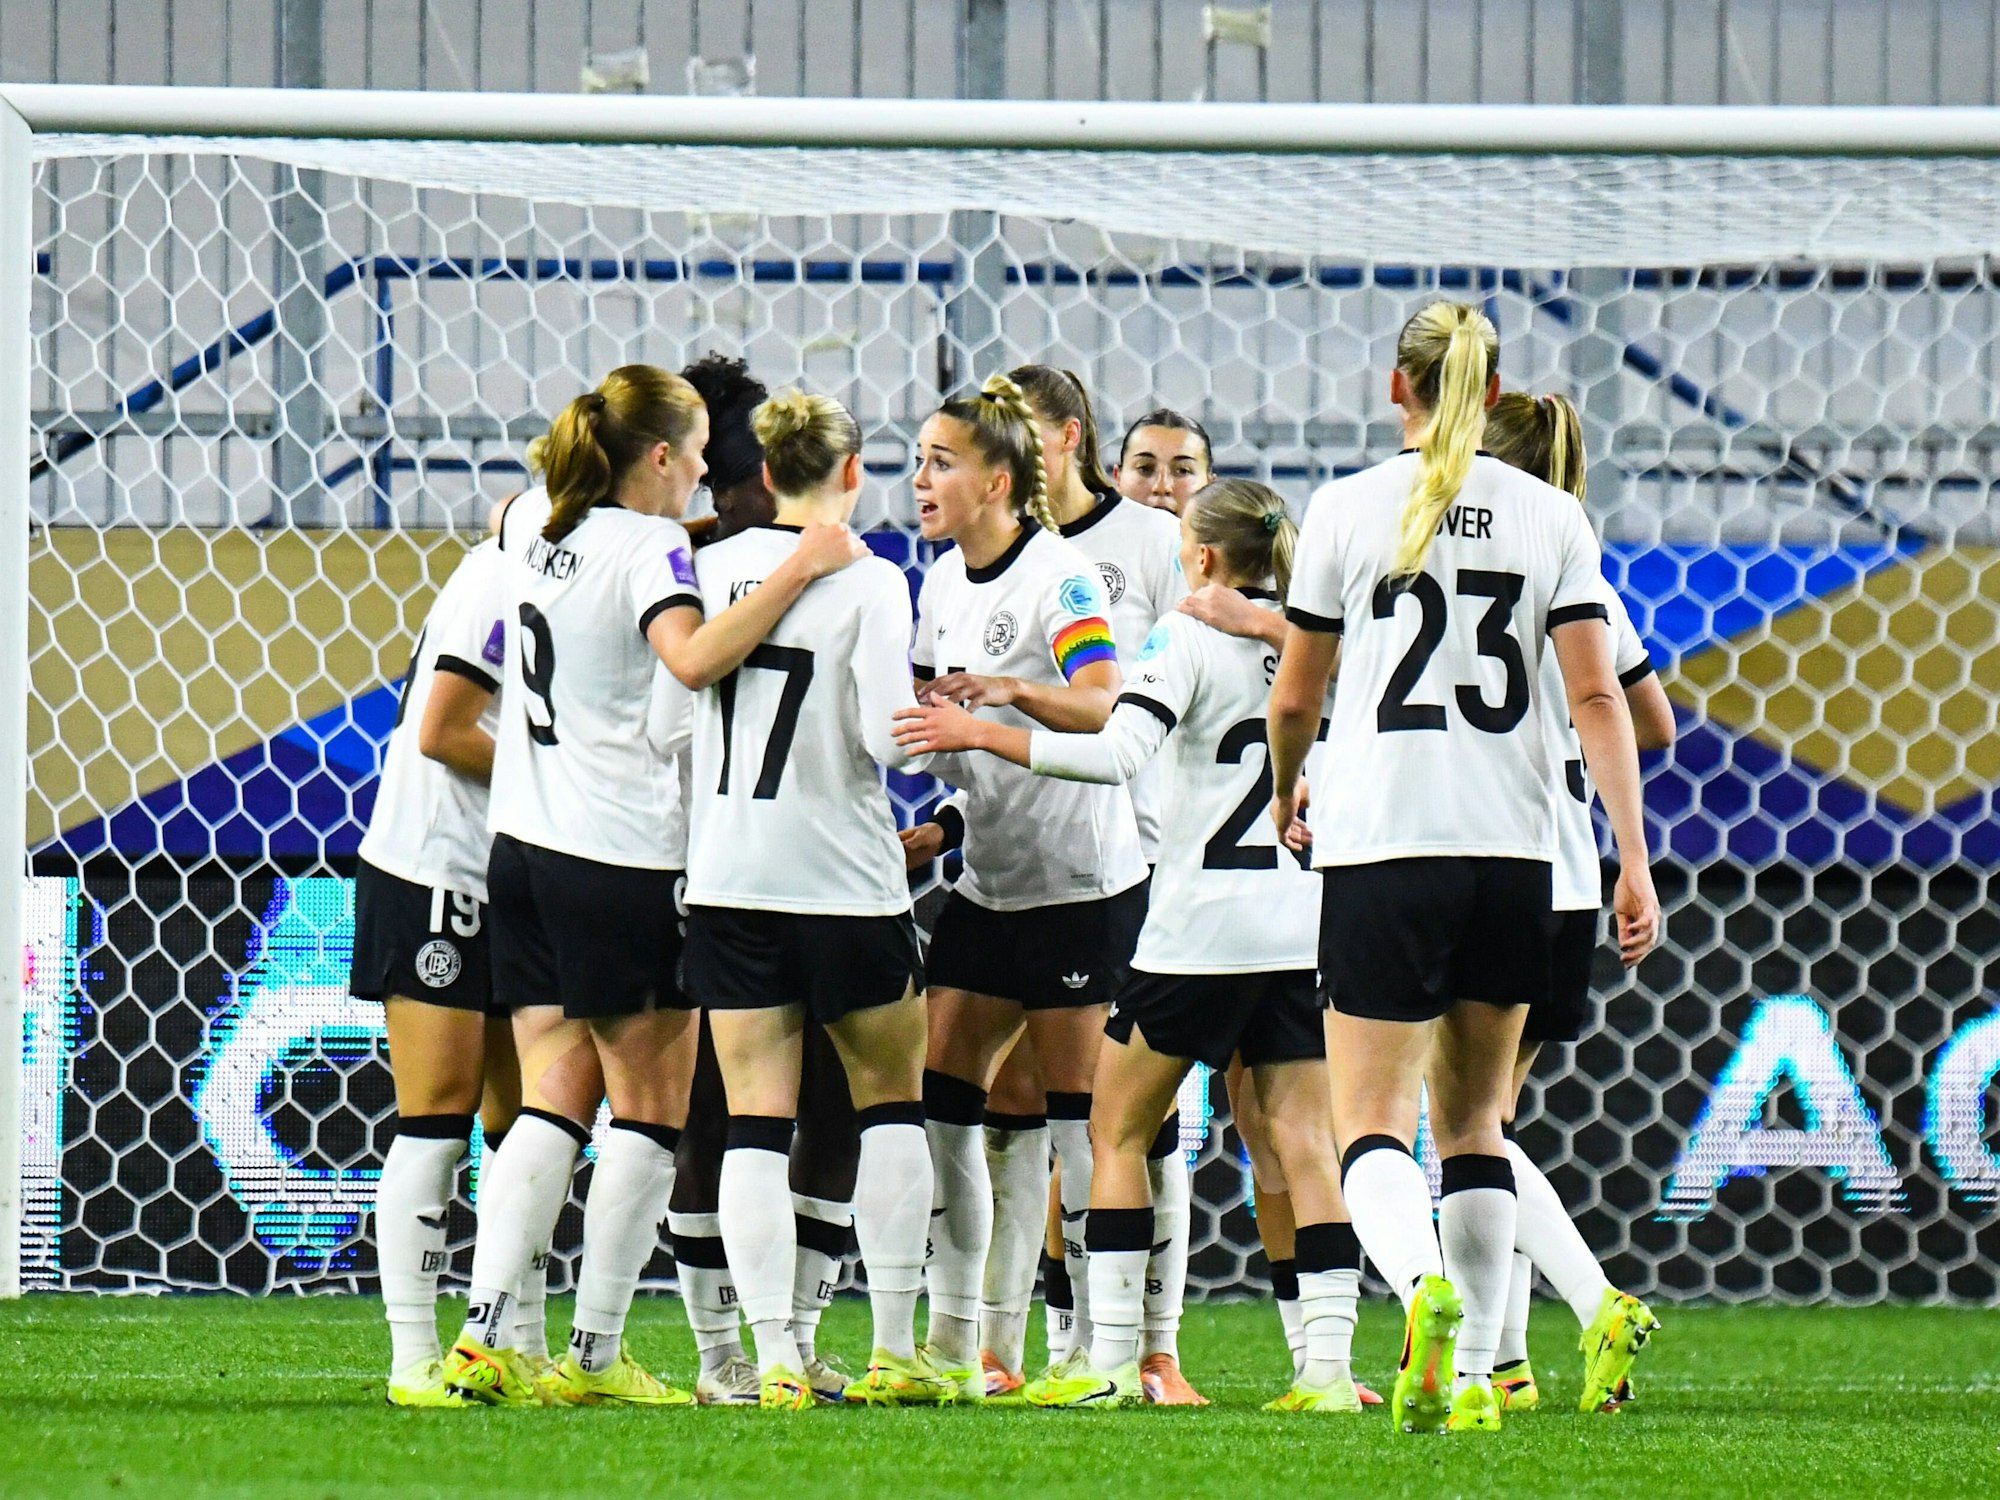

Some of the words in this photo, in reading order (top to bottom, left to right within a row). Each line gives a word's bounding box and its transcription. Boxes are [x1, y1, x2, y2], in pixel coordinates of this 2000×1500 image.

[519, 602, 559, 746] 9
[717, 642, 815, 800] 17
[1373, 569, 1530, 734] 23
[429, 886, 481, 938] 19
